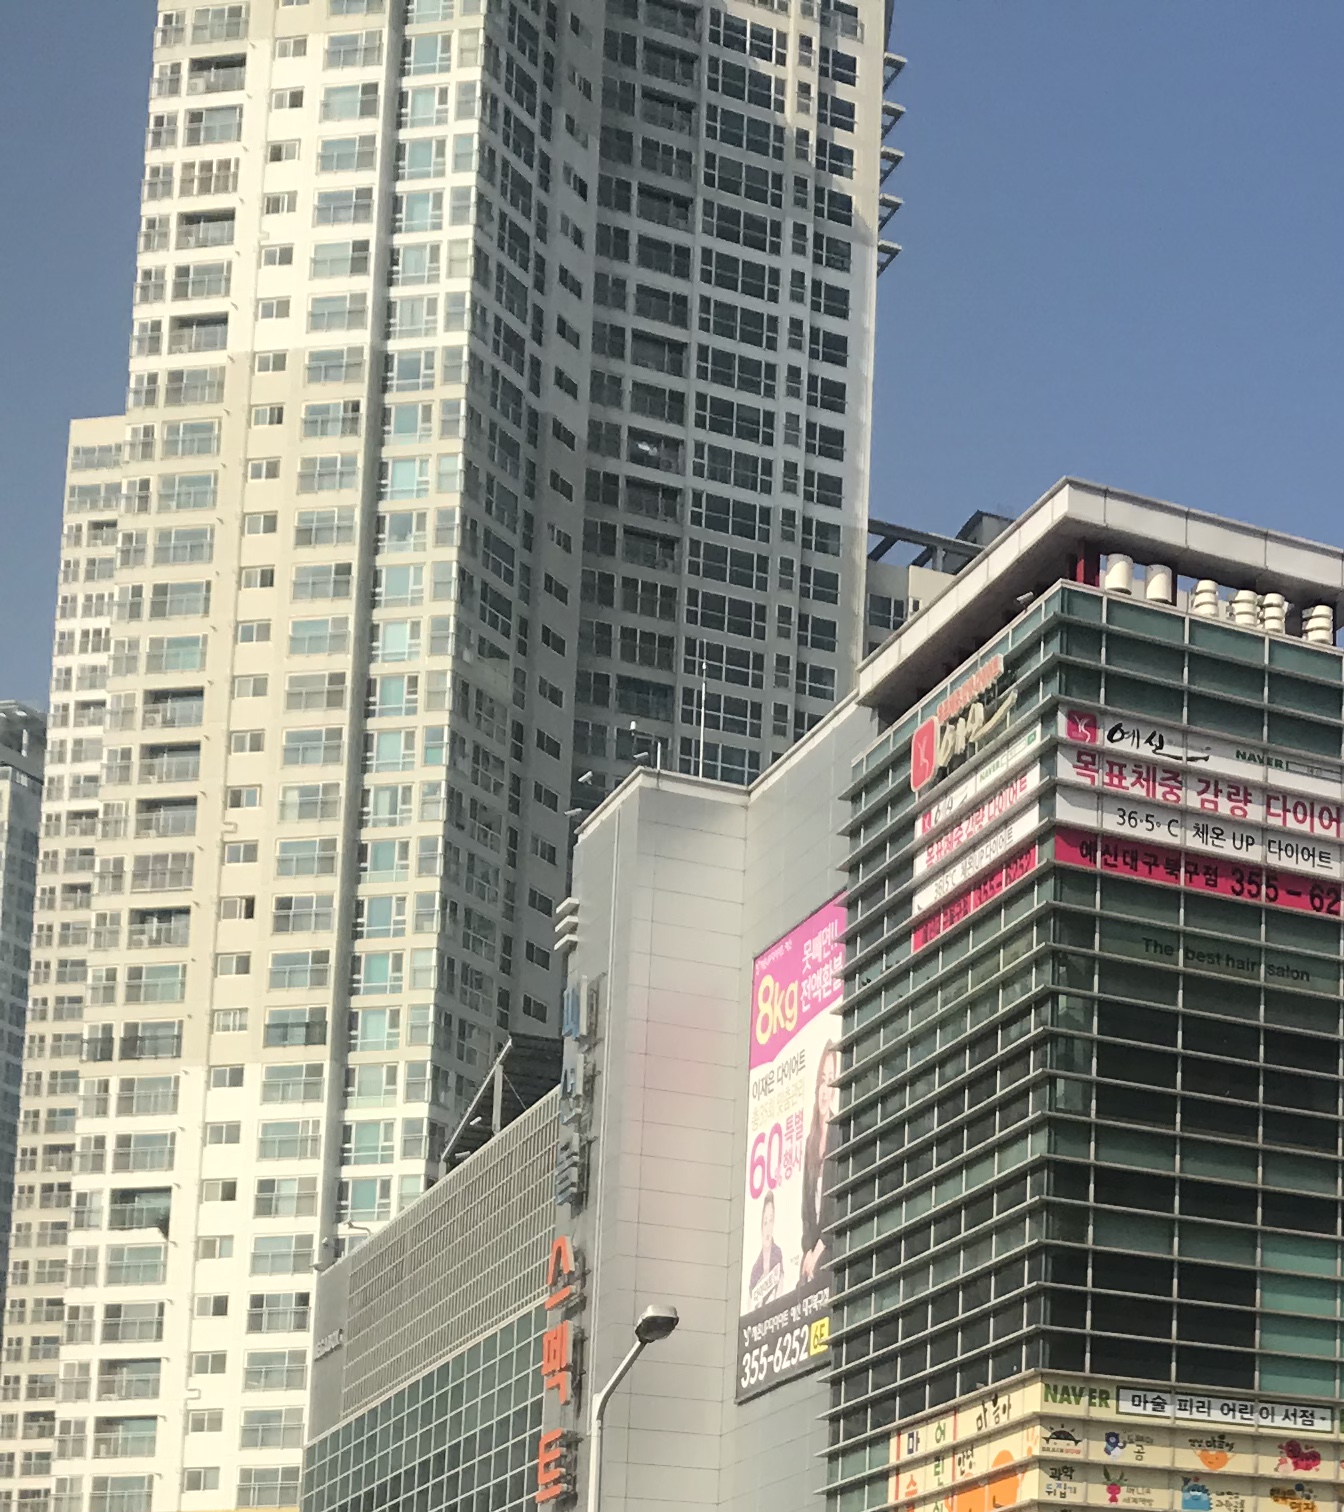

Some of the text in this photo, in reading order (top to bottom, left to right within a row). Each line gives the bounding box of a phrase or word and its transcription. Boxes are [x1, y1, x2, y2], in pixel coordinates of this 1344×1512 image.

[1235, 749, 1285, 771] NAVER
[1072, 750, 1184, 806] 목표체중
[1196, 777, 1253, 819] 감량
[1192, 821, 1228, 849] 체온
[1232, 831, 1256, 852] UP
[1267, 838, 1334, 870] 다이어트
[1184, 945, 1222, 968] best
[1224, 951, 1260, 974] hair
[1266, 960, 1311, 982] salon
[756, 973, 798, 1045] 8kg
[752, 1049, 807, 1101] 이재은 다이어트
[741, 1325, 809, 1389] 355-6252
[1043, 1383, 1111, 1409] NAVER
[1131, 1393, 1316, 1428] 마술 피리 어린이 서점
[1050, 1465, 1075, 1480] 과학
